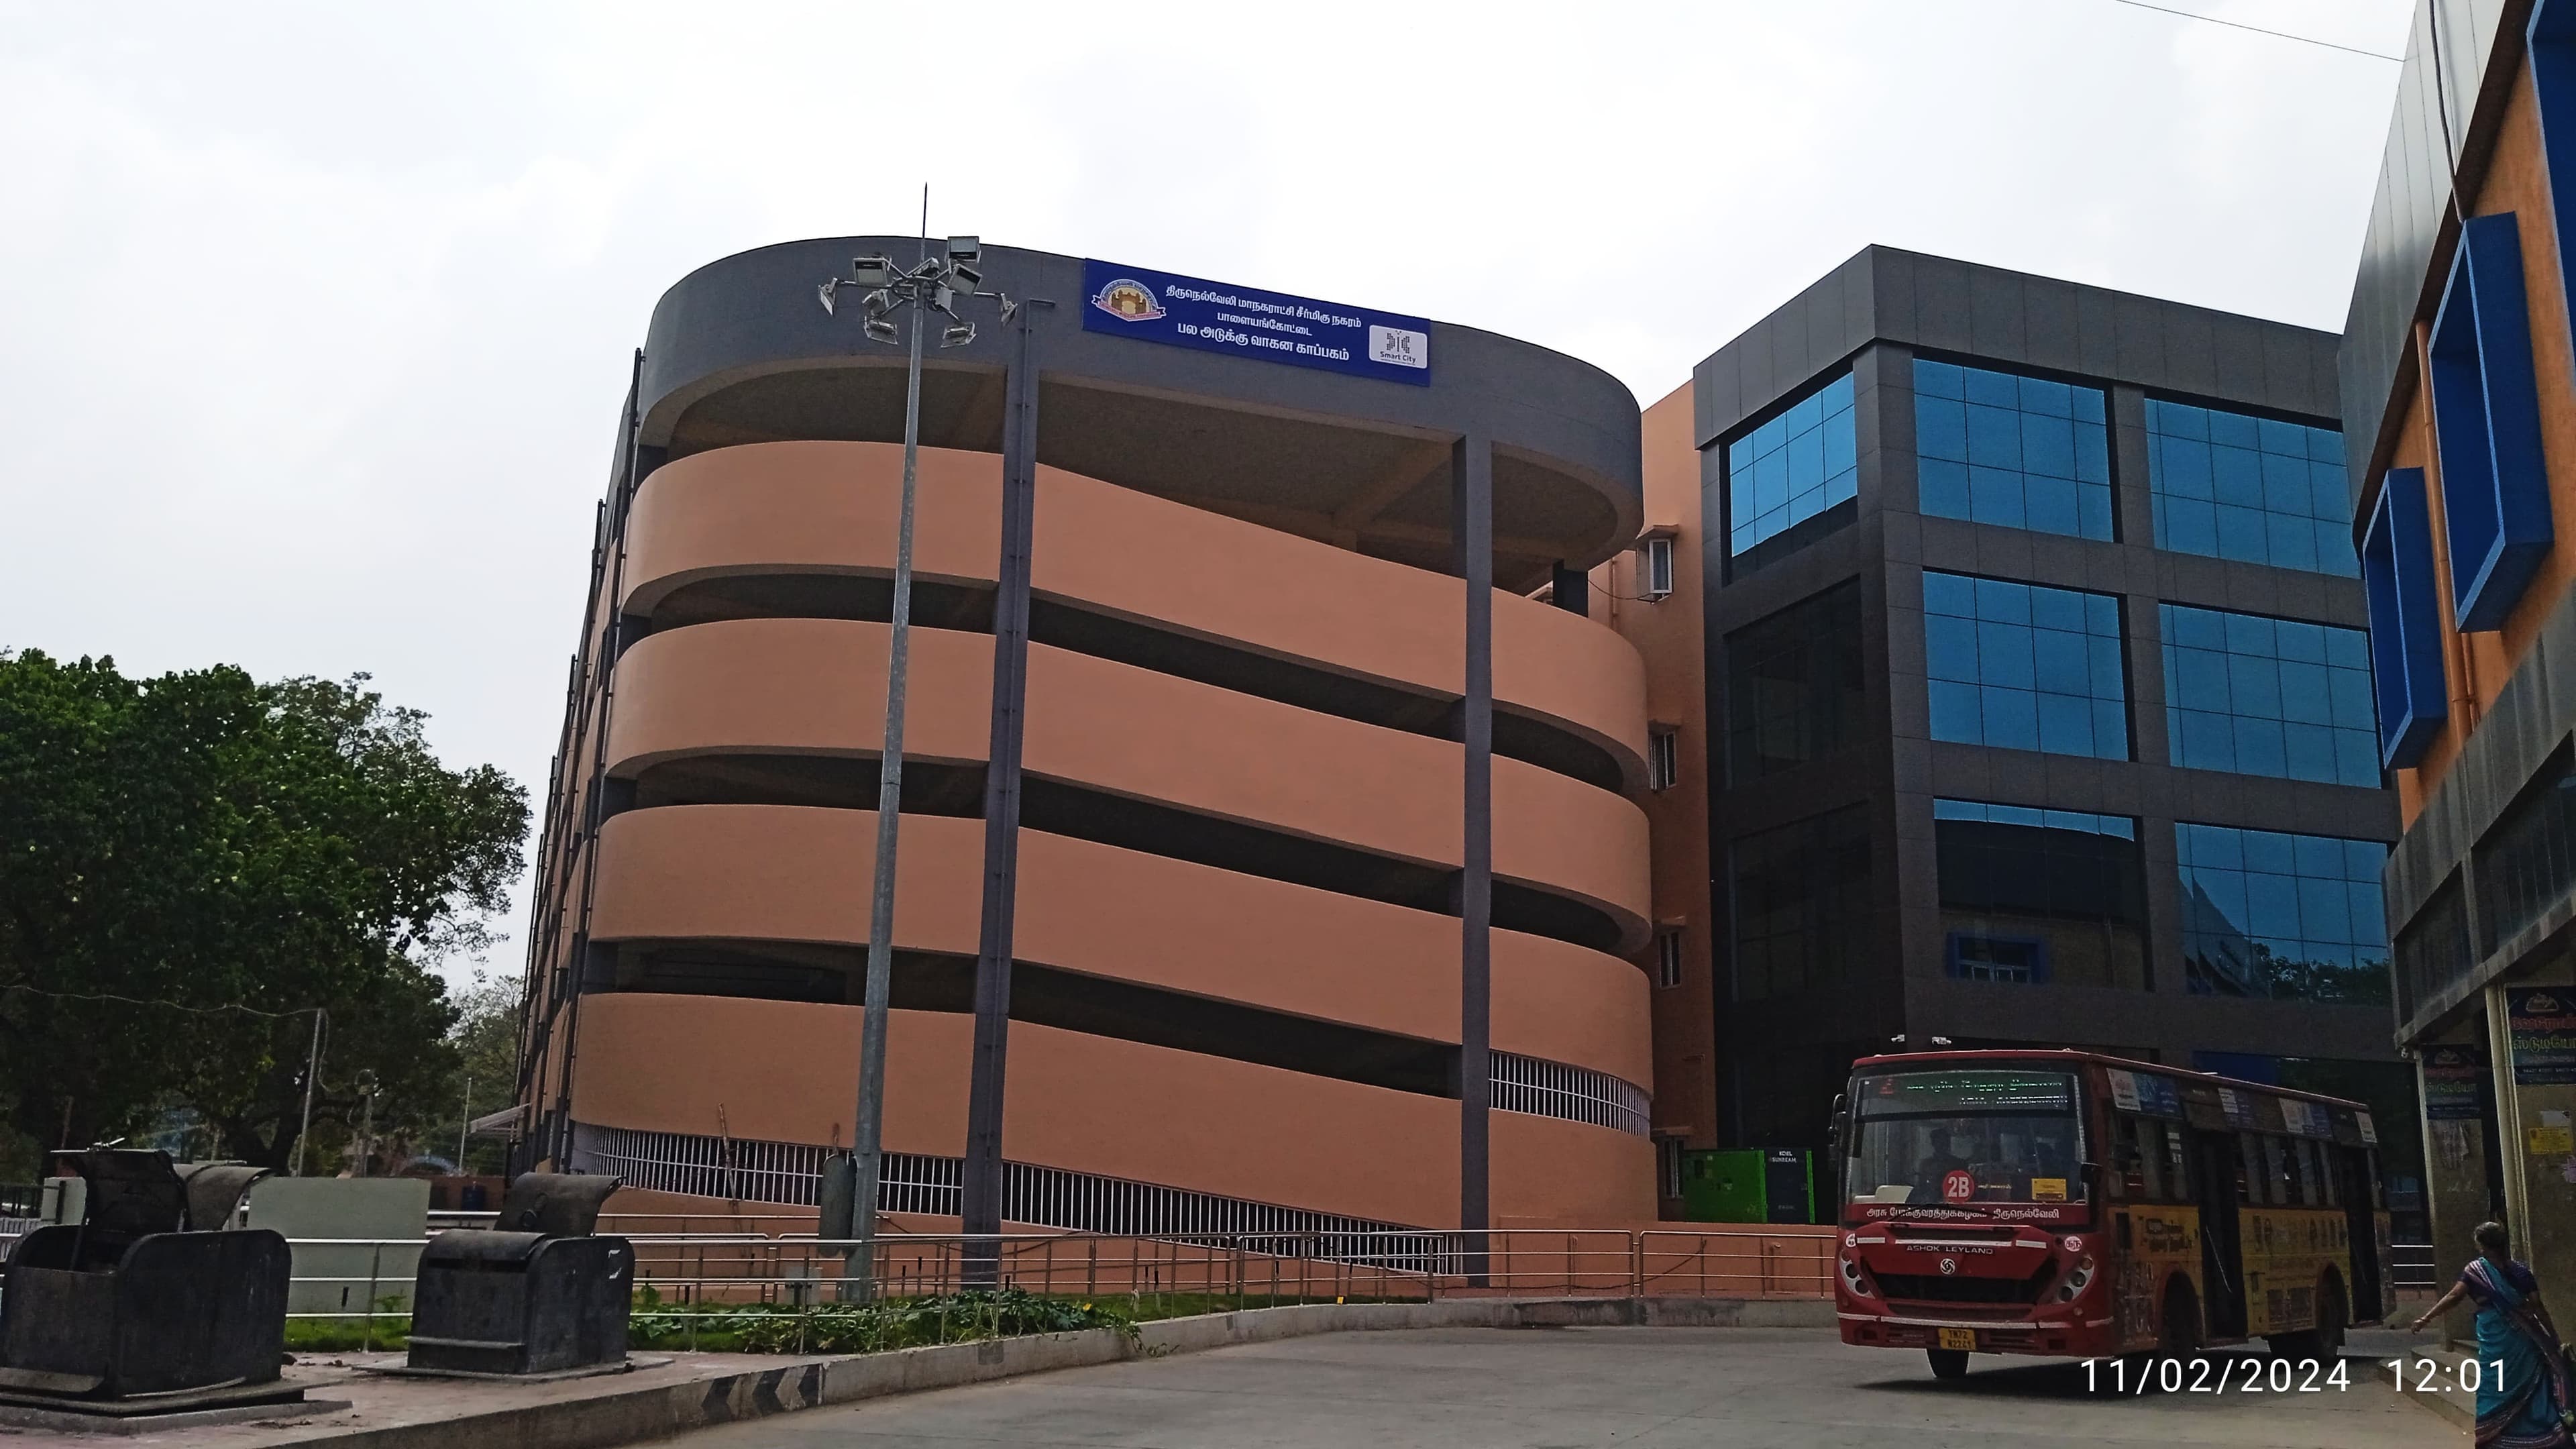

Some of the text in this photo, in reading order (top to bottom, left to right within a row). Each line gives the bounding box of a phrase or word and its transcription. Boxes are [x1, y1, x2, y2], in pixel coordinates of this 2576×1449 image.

[1166, 284, 1236, 307] திருநெல்வேலி
[1238, 299, 1294, 317] மாநகராட்சி
[1296, 306, 1330, 323] சீர்மிகு
[1332, 315, 1362, 327] நகரம்
[1218, 312, 1312, 336] பாளையங்கோட்டை
[1178, 323, 1350, 361] பல அடுக்கு வாகன காப்பகம்
[1380, 351, 1401, 360] Smart
[1402, 355, 1416, 364] City
[1947, 1176, 1970, 1198] 2B
[1945, 1246, 1993, 1254] LEYLAND
